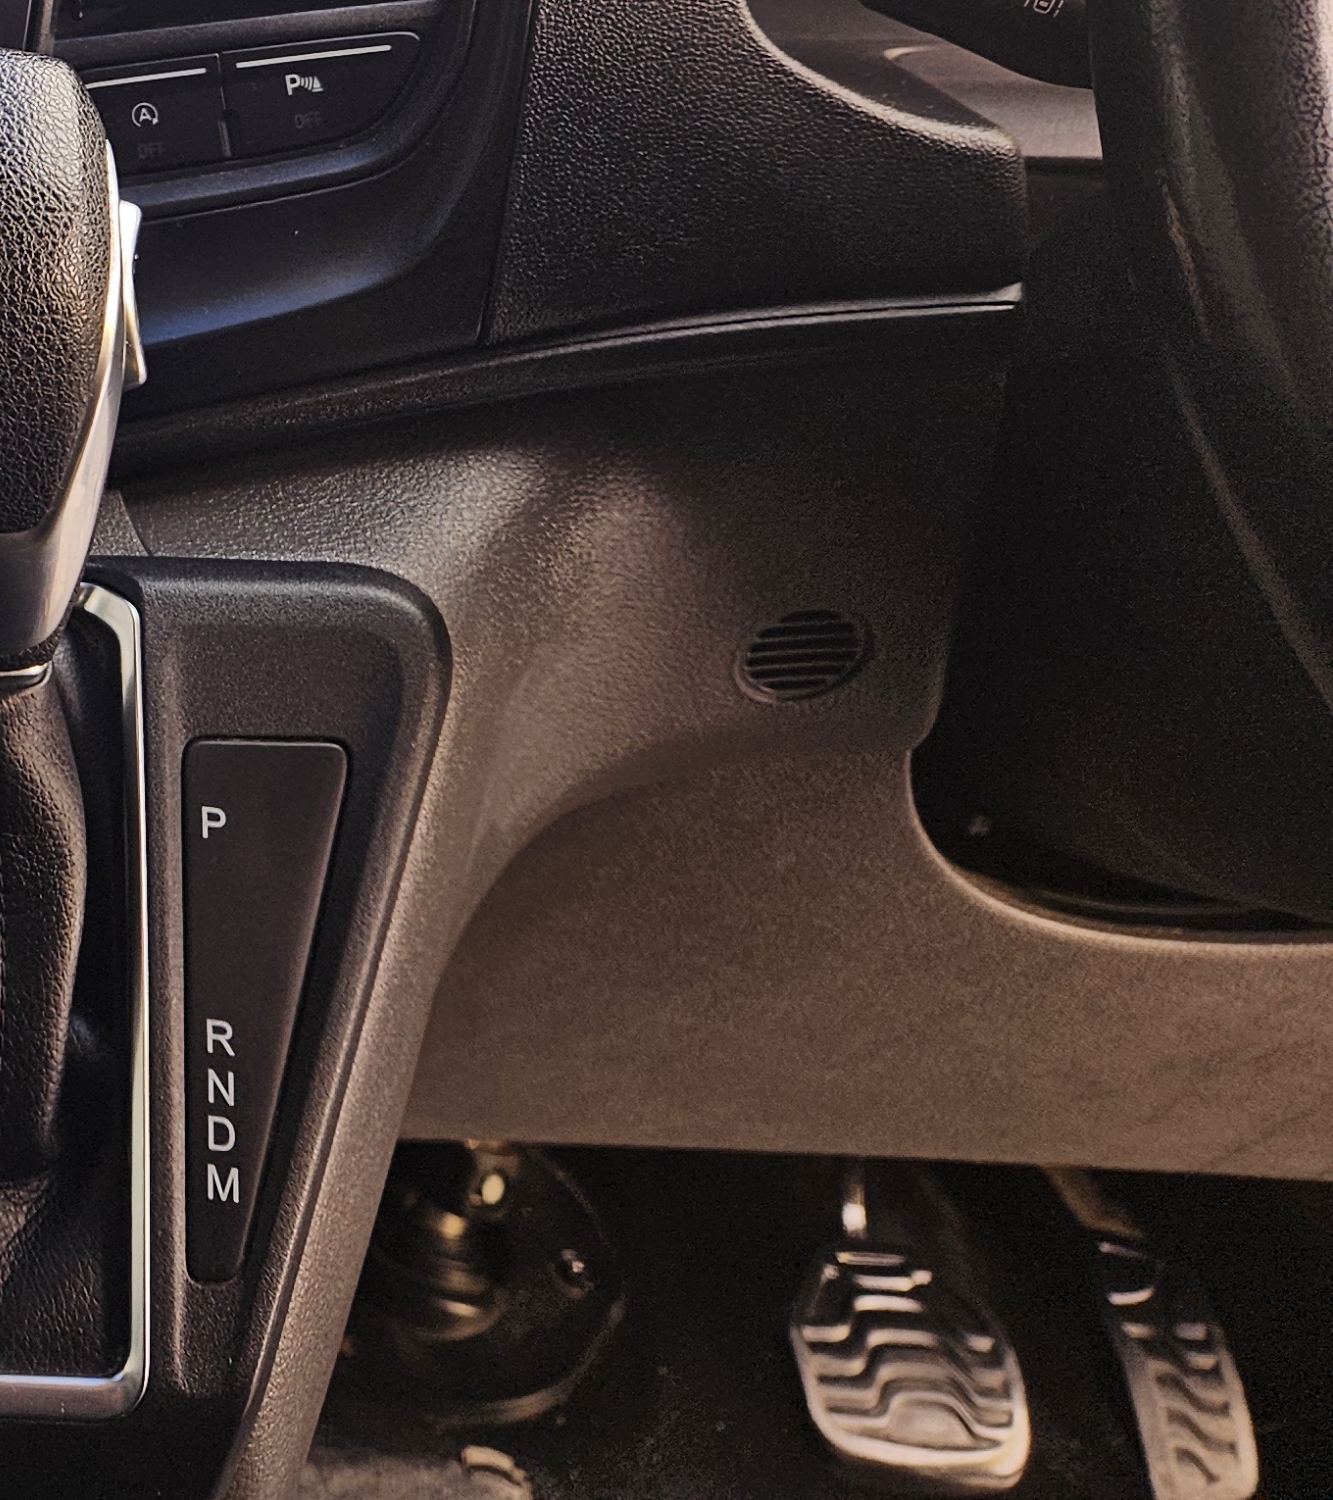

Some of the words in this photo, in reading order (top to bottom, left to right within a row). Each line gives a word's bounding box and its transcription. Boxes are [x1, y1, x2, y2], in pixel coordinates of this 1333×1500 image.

[200, 805, 227, 839] P
[205, 1018, 236, 1057] R
[207, 1068, 235, 1107] N
[207, 1114, 236, 1153] D
[207, 1163, 240, 1204] M
